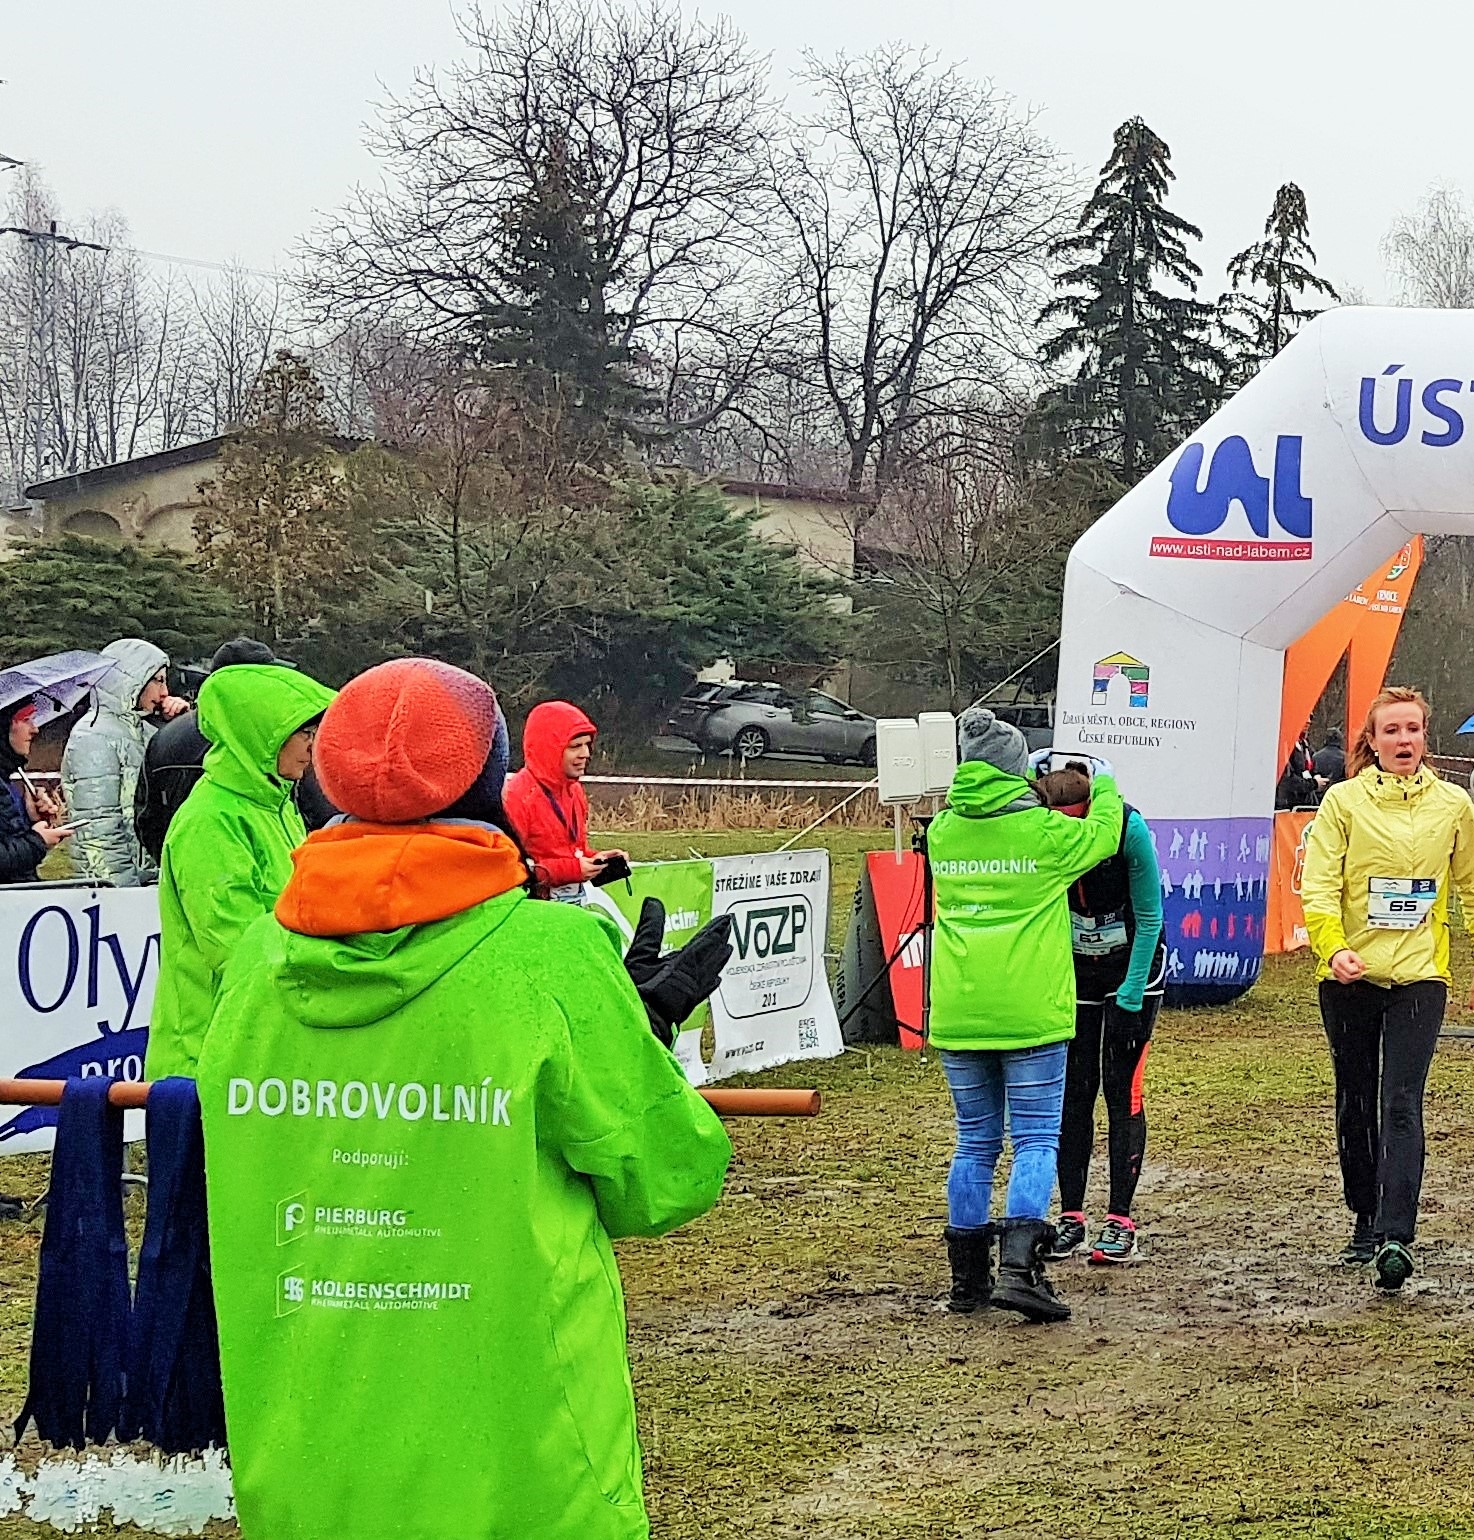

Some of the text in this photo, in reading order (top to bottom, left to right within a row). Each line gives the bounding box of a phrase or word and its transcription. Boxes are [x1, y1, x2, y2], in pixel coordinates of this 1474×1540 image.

[1152, 542, 1310, 558] www.usti-nad-labem.cz
[1151, 718, 1196, 731] REGIONY
[1107, 734, 1162, 747] REPUBLIKY
[933, 855, 1038, 875] DOBROVOLNÍK
[765, 870, 788, 887] VAŠE
[1390, 901, 1417, 911] 65
[729, 905, 806, 959] VoZP
[227, 1076, 512, 1127] DOBROVOLNÍK
[332, 1148, 409, 1169] Podporují:
[315, 1207, 406, 1226] PIERBURG
[312, 1280, 471, 1300] KOLBENSCHMIDT
